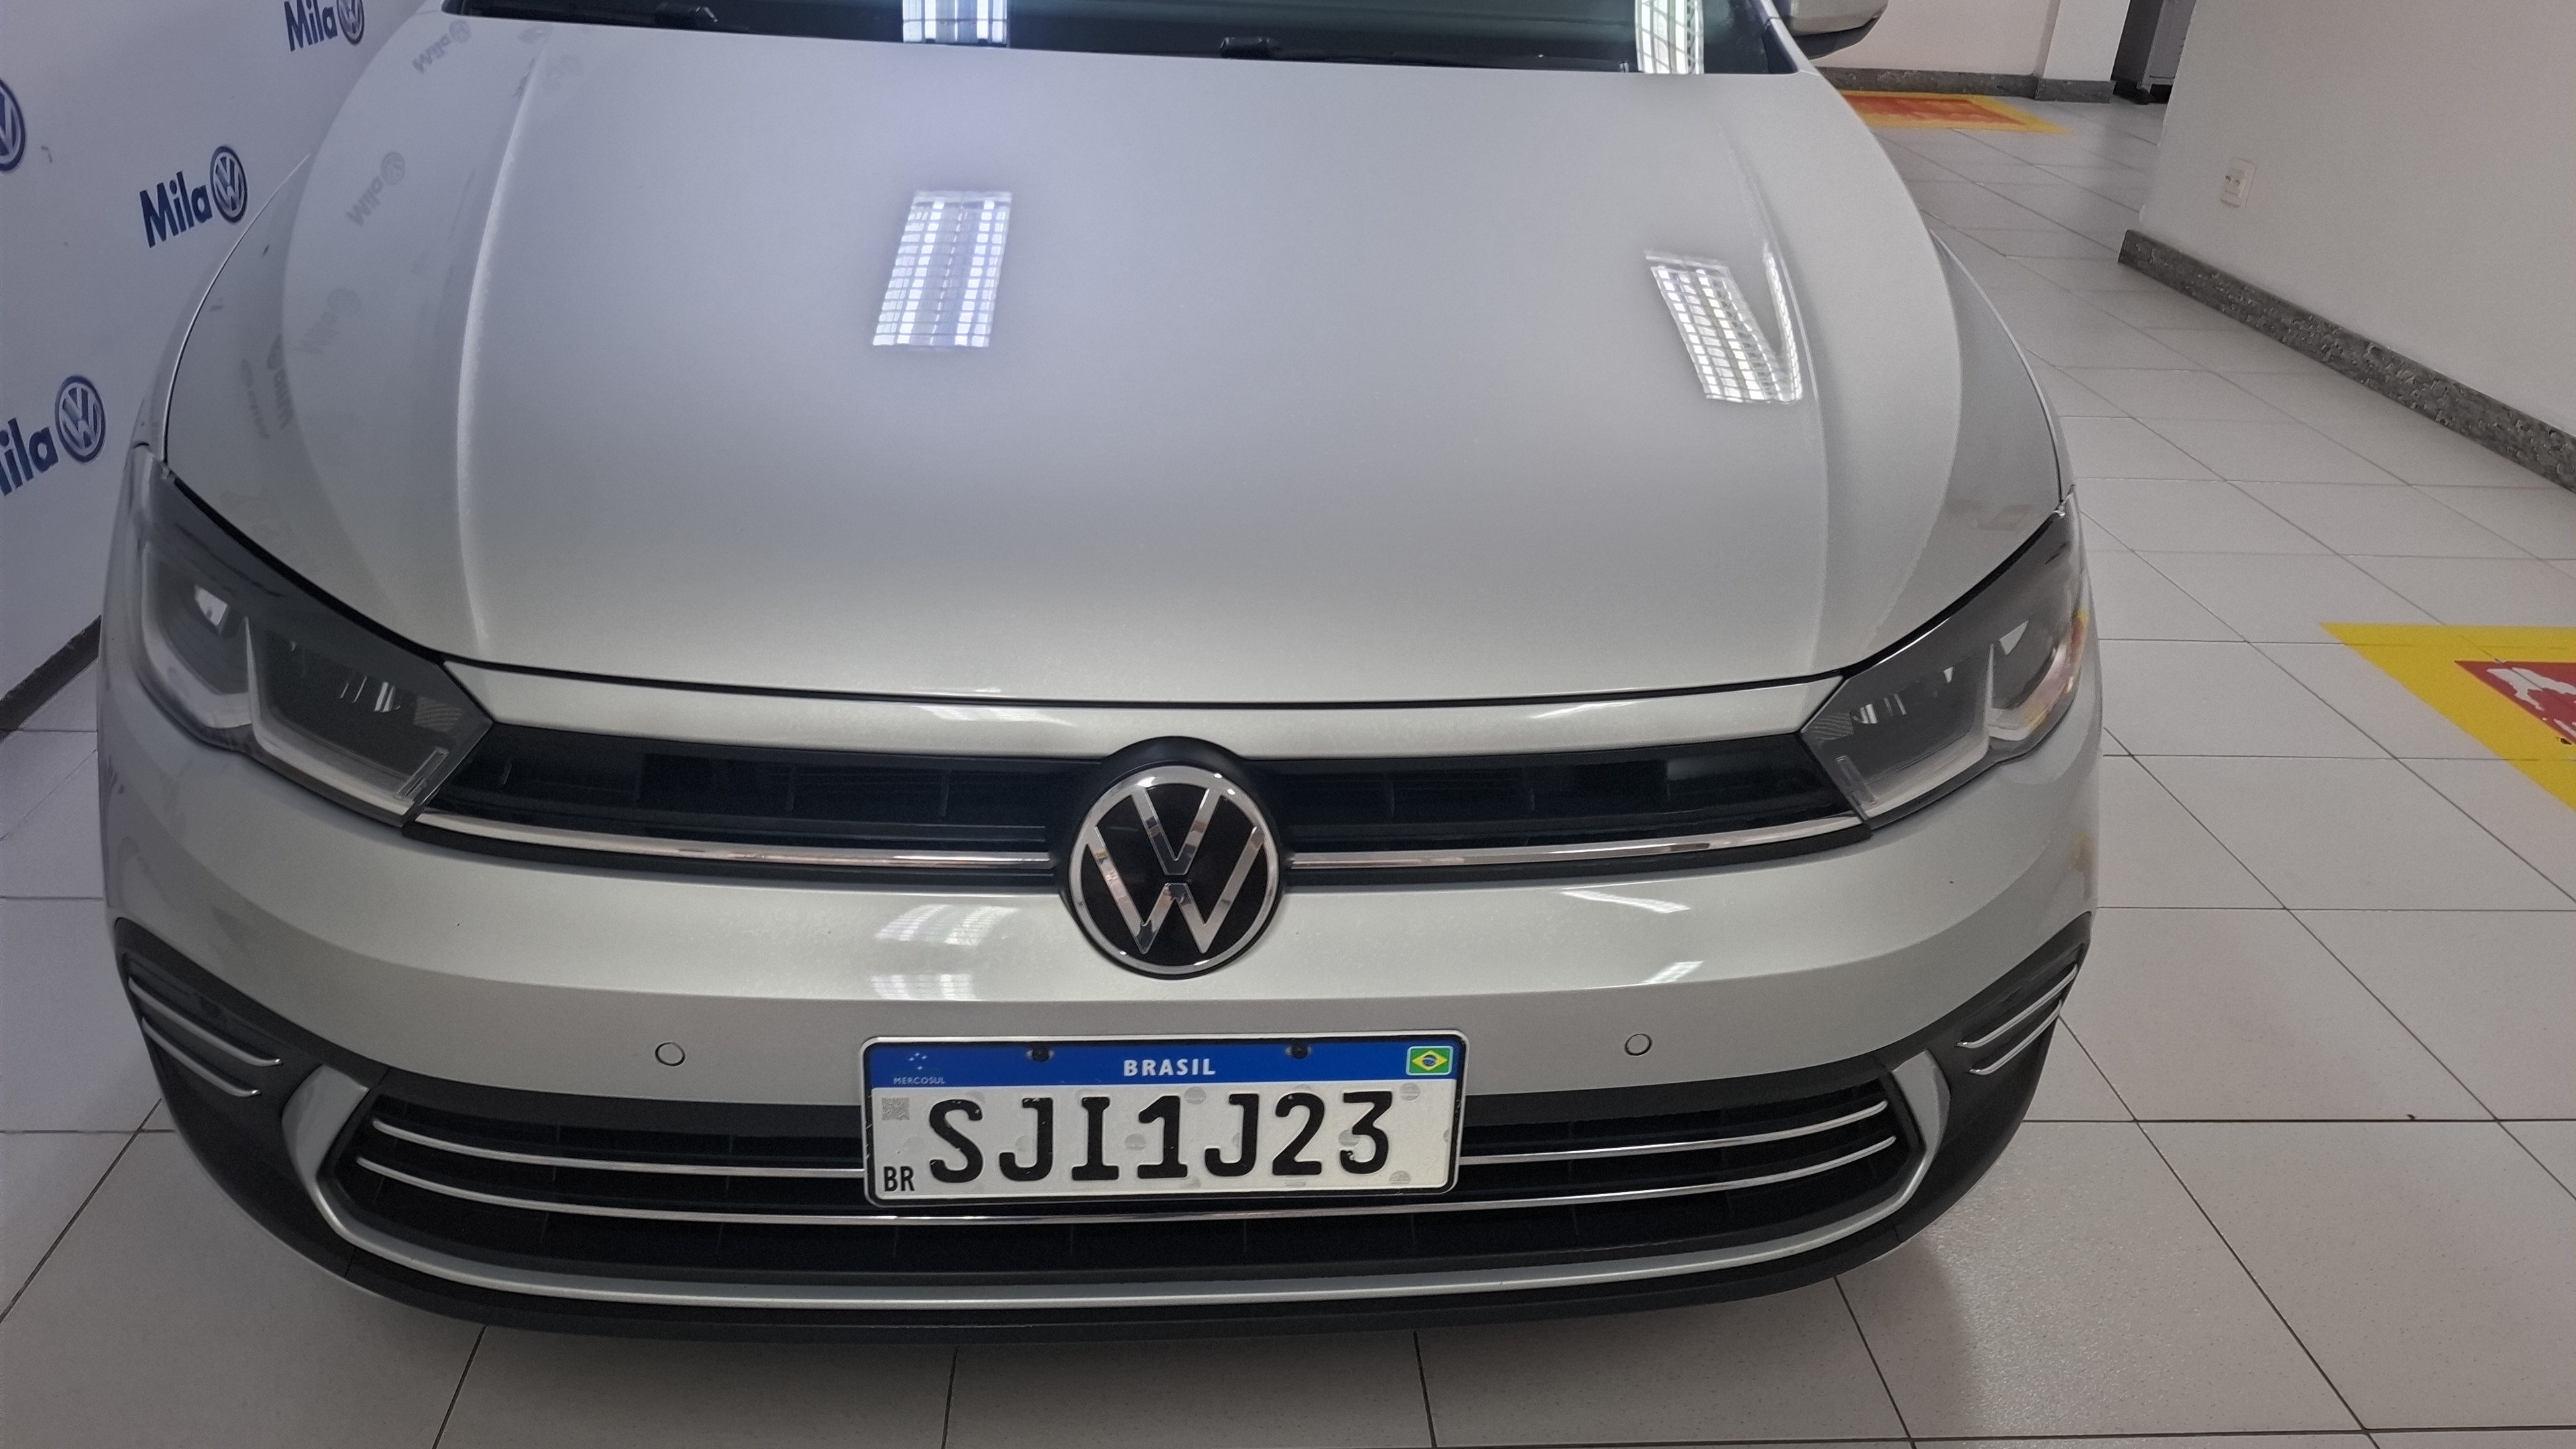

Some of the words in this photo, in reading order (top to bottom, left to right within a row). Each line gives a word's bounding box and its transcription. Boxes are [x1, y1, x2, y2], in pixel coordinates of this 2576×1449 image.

[284, 0, 337, 51] Mila
[140, 171, 213, 248] Mila
[0, 417, 58, 497] ila
[893, 1076, 947, 1085] MERCOSUL
[1123, 1058, 1216, 1077] BRASIL
[928, 1090, 1393, 1184] SJI1J23
[883, 1165, 916, 1192] BR
